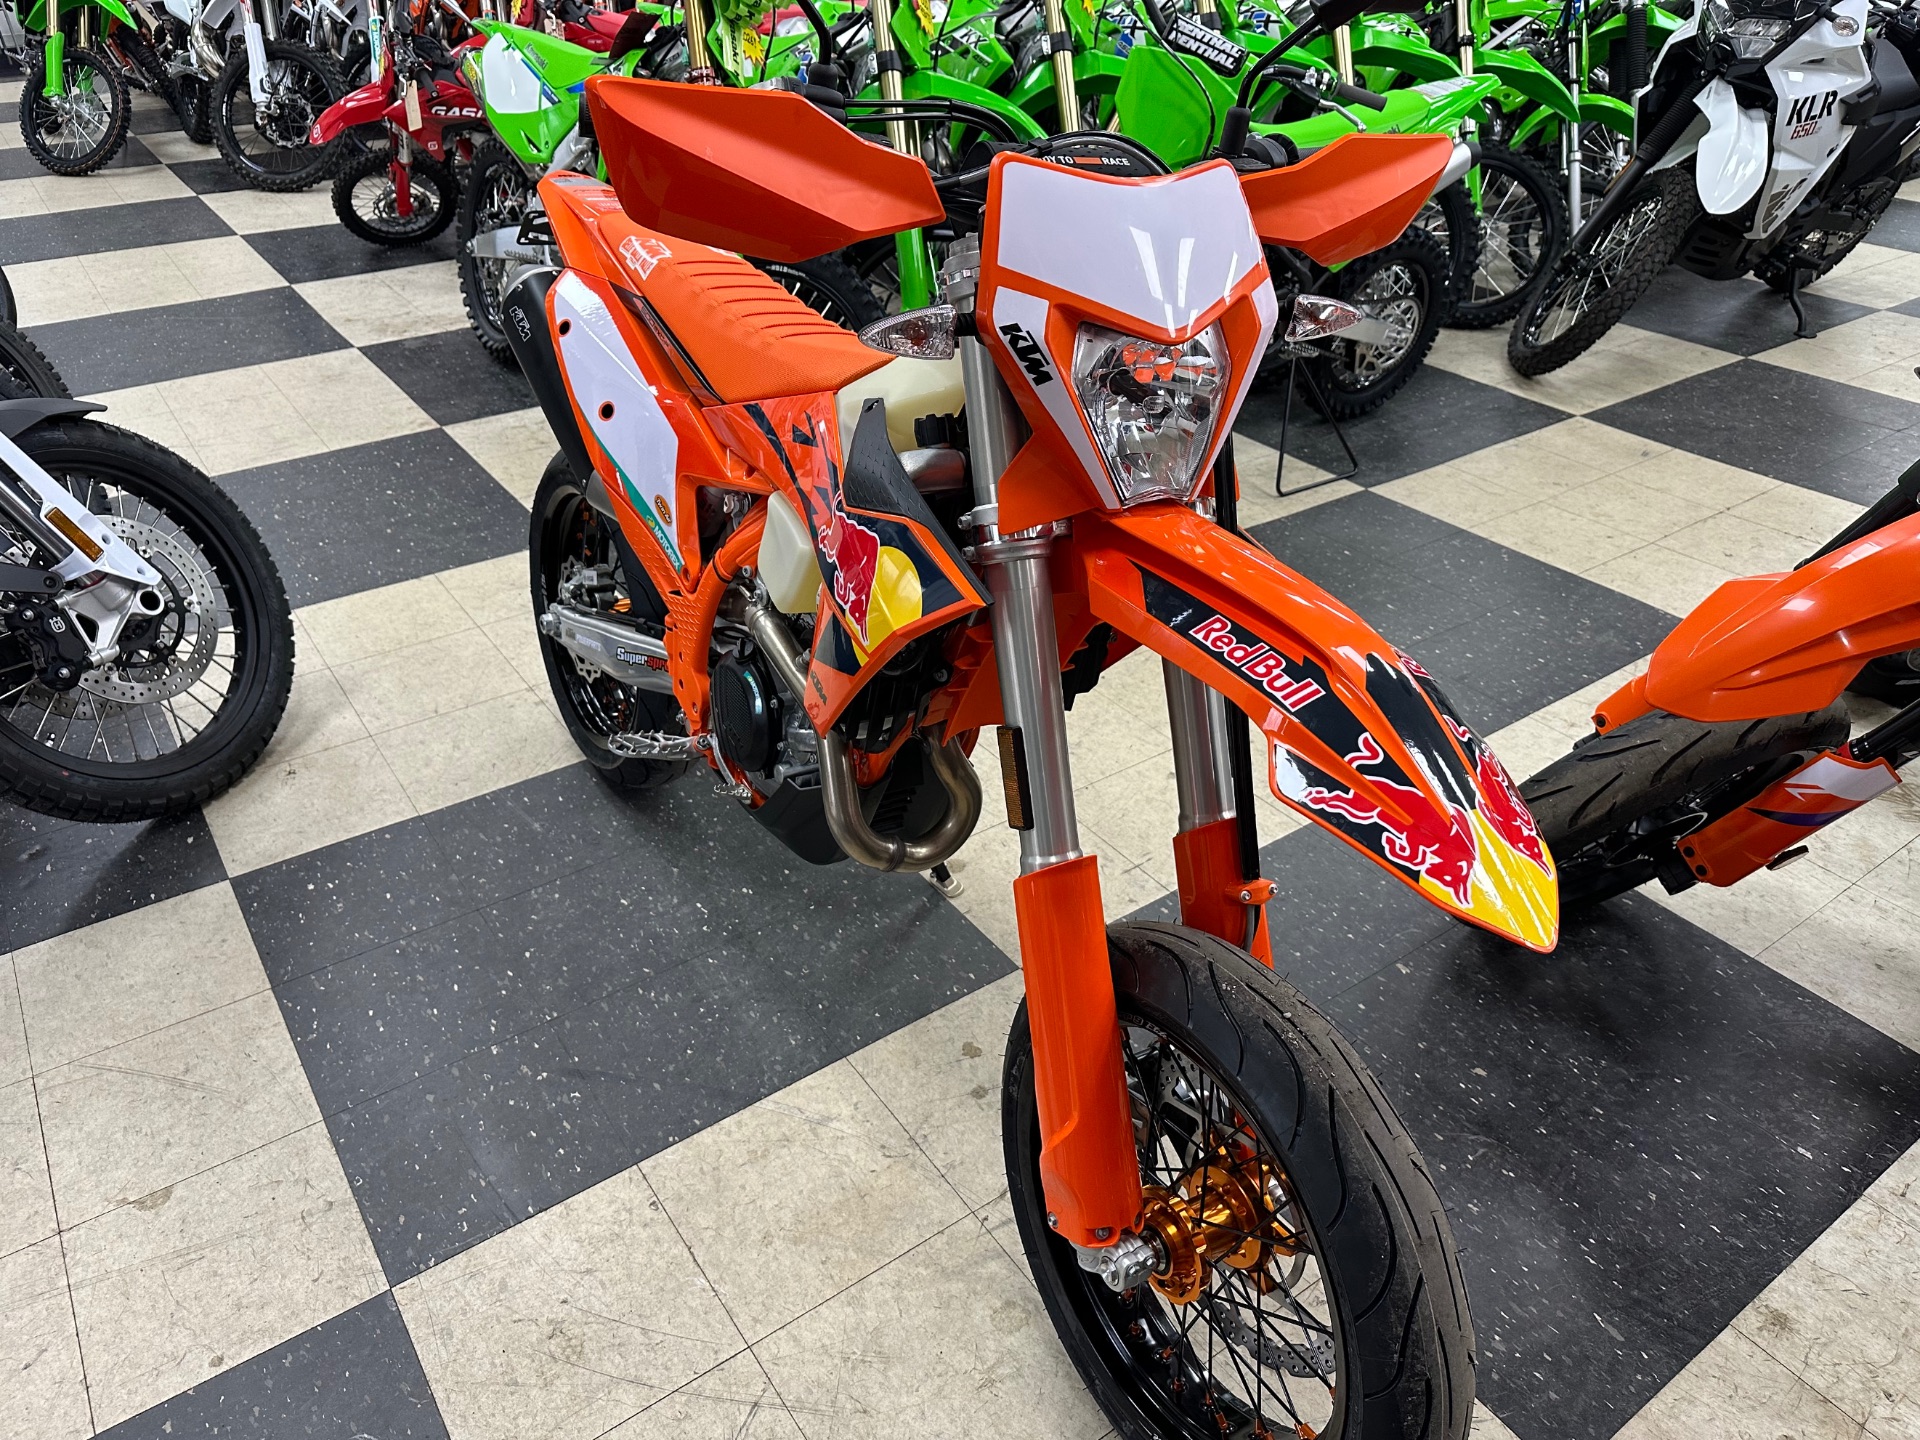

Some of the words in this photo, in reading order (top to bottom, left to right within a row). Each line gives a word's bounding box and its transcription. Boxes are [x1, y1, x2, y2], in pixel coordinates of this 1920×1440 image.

[960, 27, 989, 49] KX
[1785, 90, 1839, 126] KLR
[1790, 121, 1818, 140] 650
[1058, 155, 1074, 164] TO
[1100, 157, 1131, 166] RACE
[509, 306, 531, 342] KTM
[999, 322, 1054, 387] KTM
[653, 525, 680, 571] MOTOREX
[810, 670, 828, 706] KTM
